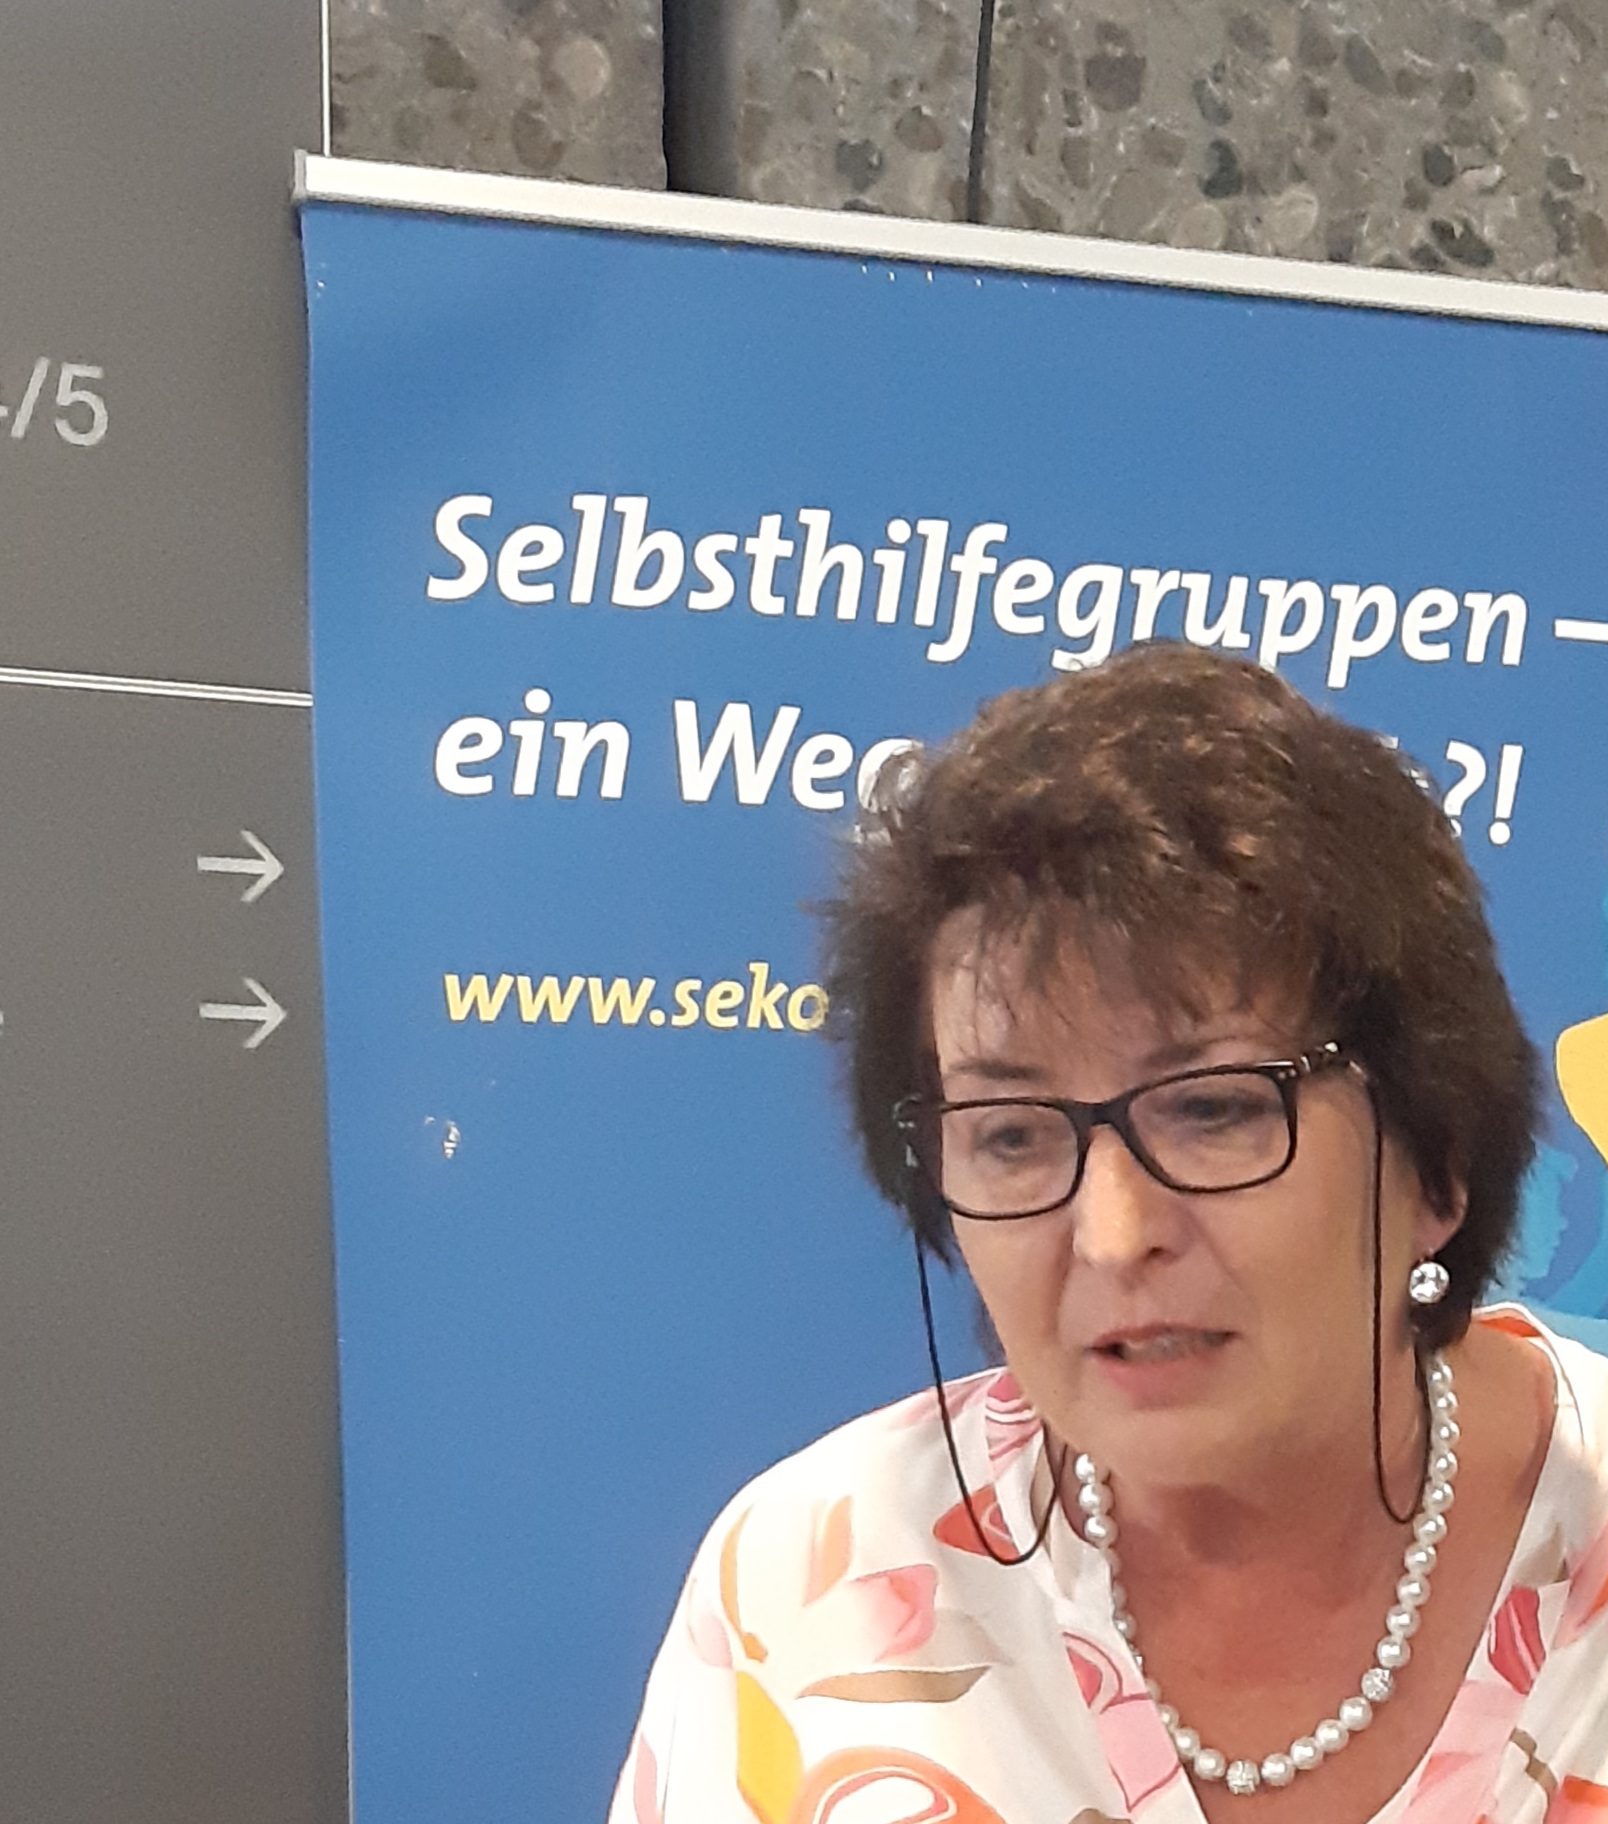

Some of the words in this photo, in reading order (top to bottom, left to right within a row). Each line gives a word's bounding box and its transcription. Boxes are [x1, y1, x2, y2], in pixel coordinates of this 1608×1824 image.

[0, 356, 109, 446] /5
[426, 494, 1528, 688] Selbsthilfegruppen
[434, 687, 630, 798] ein
